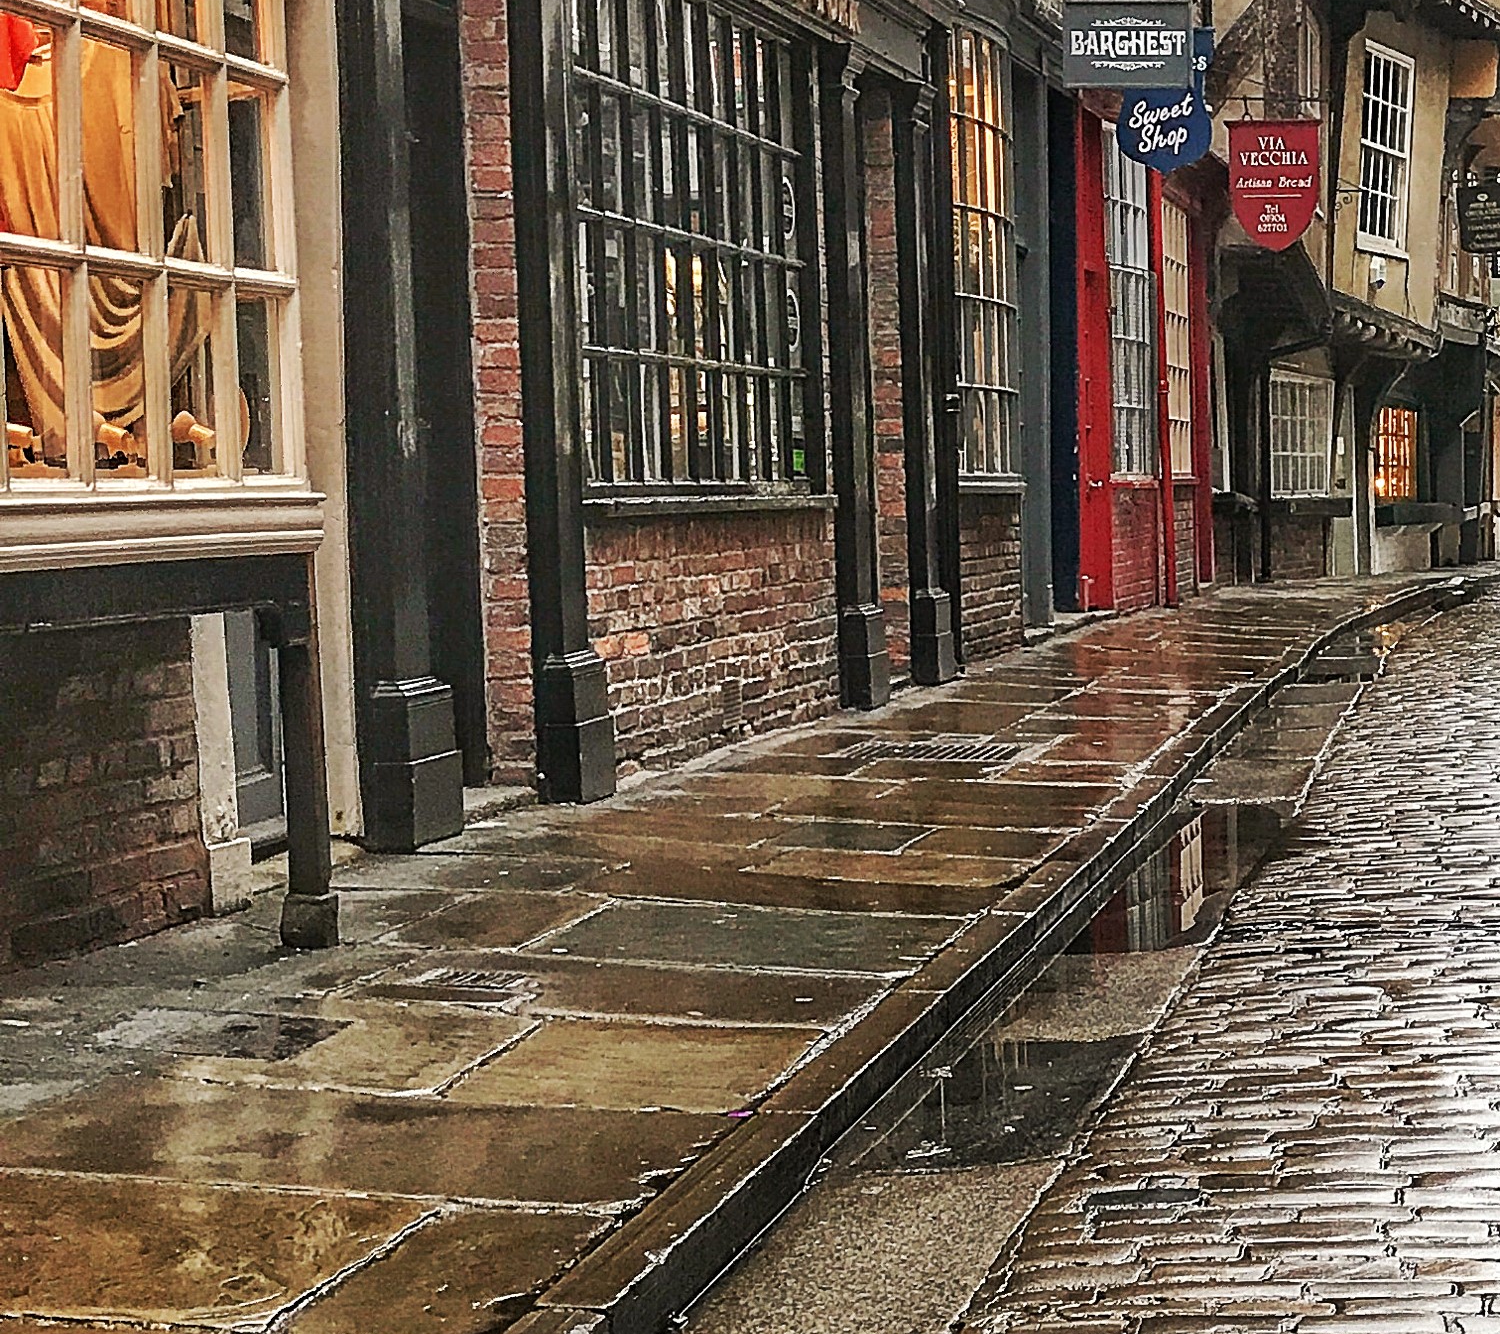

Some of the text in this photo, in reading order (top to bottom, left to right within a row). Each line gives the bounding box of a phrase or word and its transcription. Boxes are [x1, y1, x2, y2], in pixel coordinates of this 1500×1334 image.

[1070, 30, 1187, 59] BARGHEST
[1128, 92, 1194, 129] Sweet
[1138, 124, 1188, 155] Shop
[1257, 136, 1286, 150] VIA
[1239, 151, 1309, 166] VECCHIA
[1235, 174, 1313, 189] Artisan Bread
[1264, 204, 1279, 214] Tel
[1259, 213, 1286, 223] 01904
